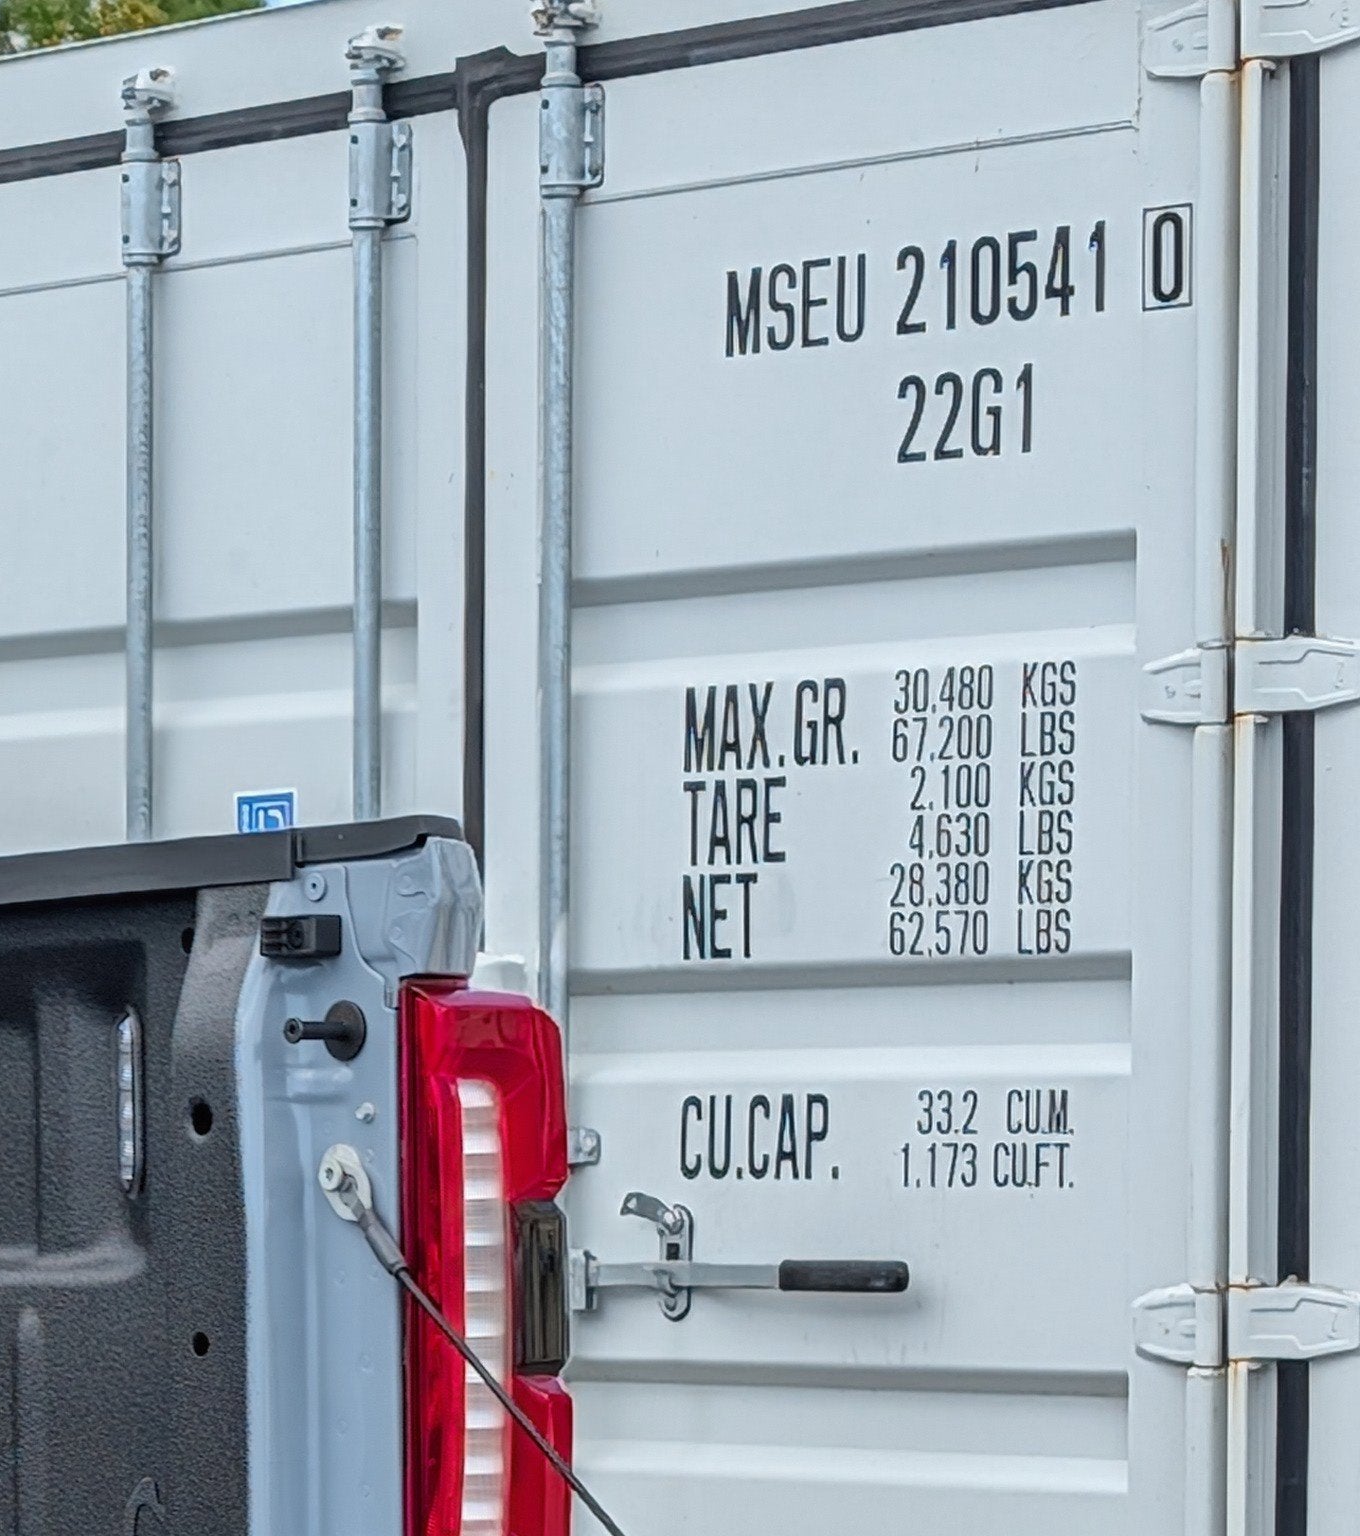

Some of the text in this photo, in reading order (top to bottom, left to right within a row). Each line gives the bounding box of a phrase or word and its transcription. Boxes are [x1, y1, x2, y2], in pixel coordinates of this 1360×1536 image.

[726, 211, 1183, 357] MSEU 210541 0
[897, 363, 1033, 463] 22G1
[1021, 661, 1076, 708] KGS
[1021, 710, 1075, 757] LBS
[1019, 760, 1075, 807] KGS
[683, 776, 786, 866] TARE
[1019, 809, 1073, 855] LBS
[1017, 859, 1072, 905] KGS
[683, 873, 758, 960] NET
[1017, 908, 1071, 955] LBS
[917, 1089, 978, 1135] 33.2
